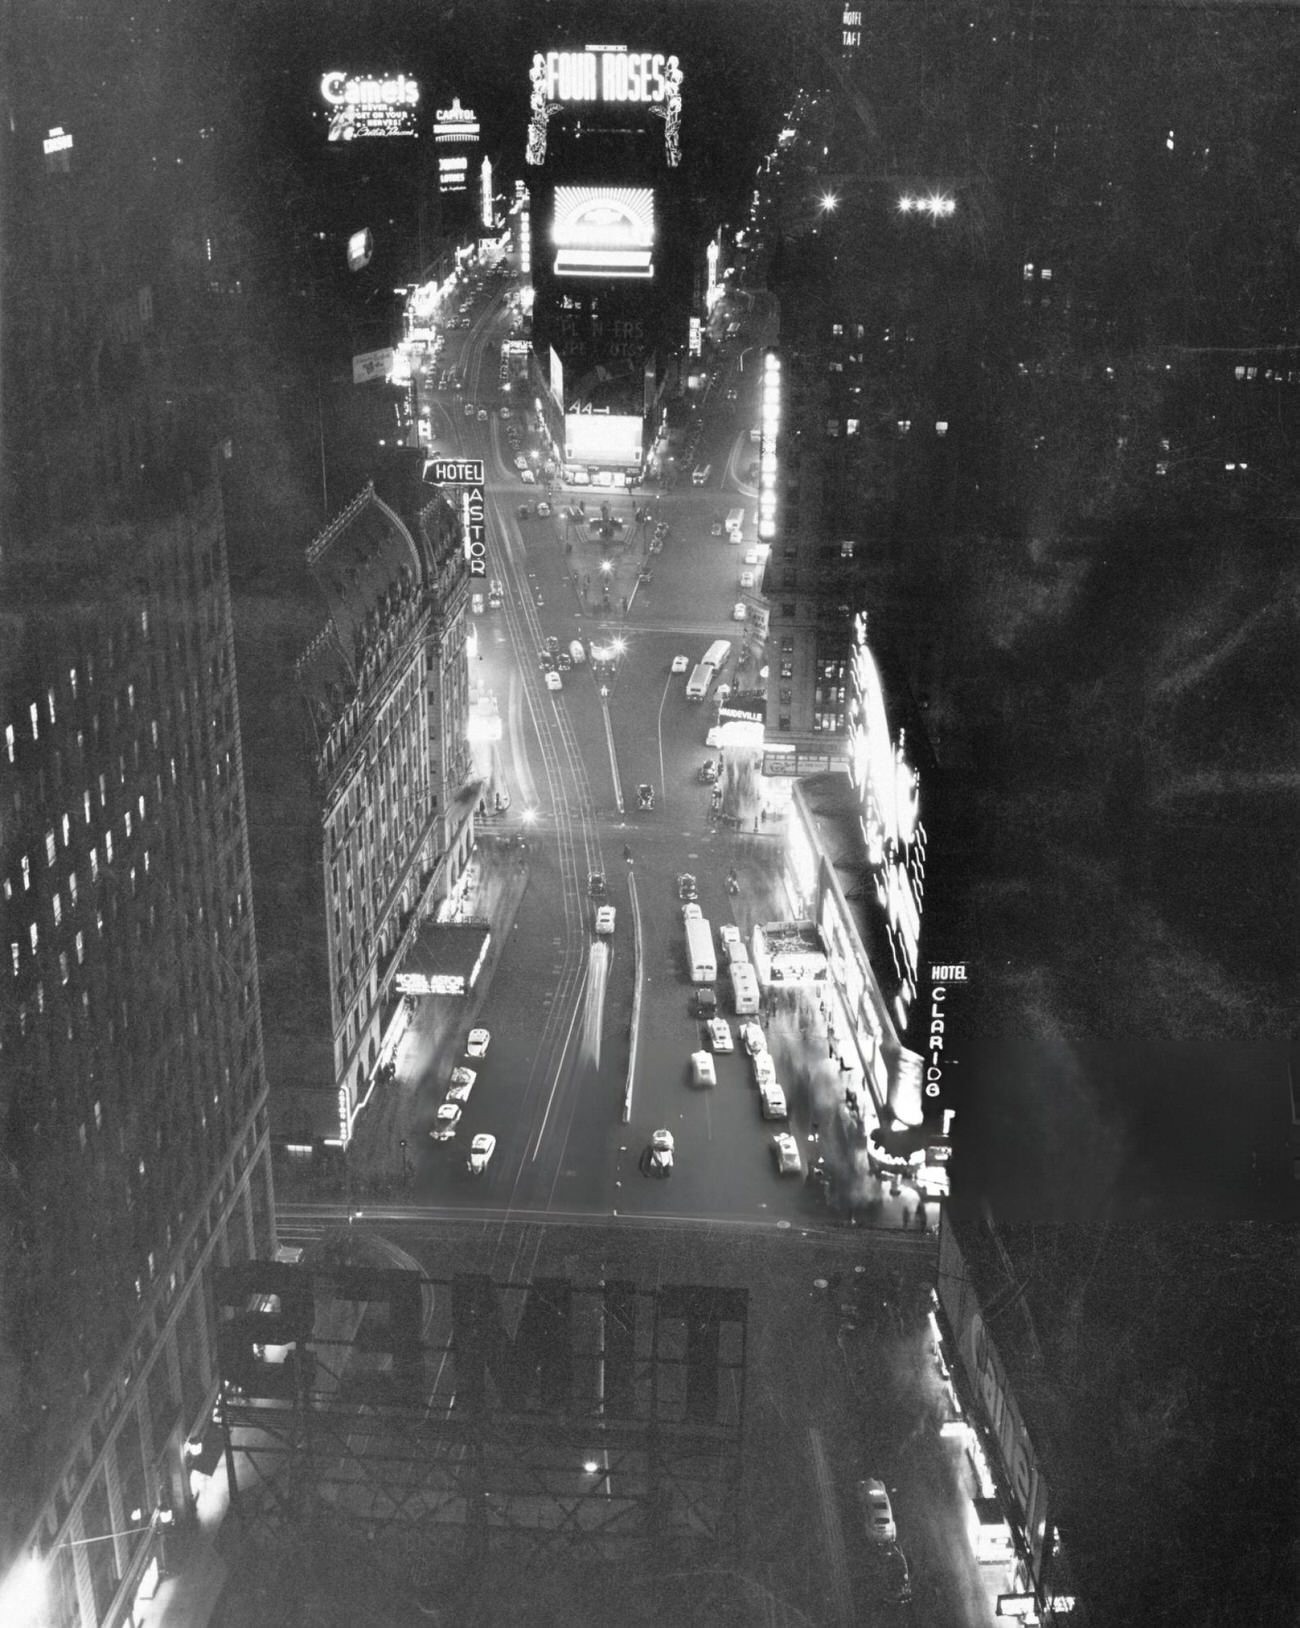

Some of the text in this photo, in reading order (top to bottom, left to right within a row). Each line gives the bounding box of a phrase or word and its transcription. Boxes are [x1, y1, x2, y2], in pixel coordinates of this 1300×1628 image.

[547, 52, 665, 102] FOUR ROSES
[436, 464, 483, 480] HOTEL
[470, 488, 485, 575] ASTOR
[932, 965, 967, 980] HOTEL
